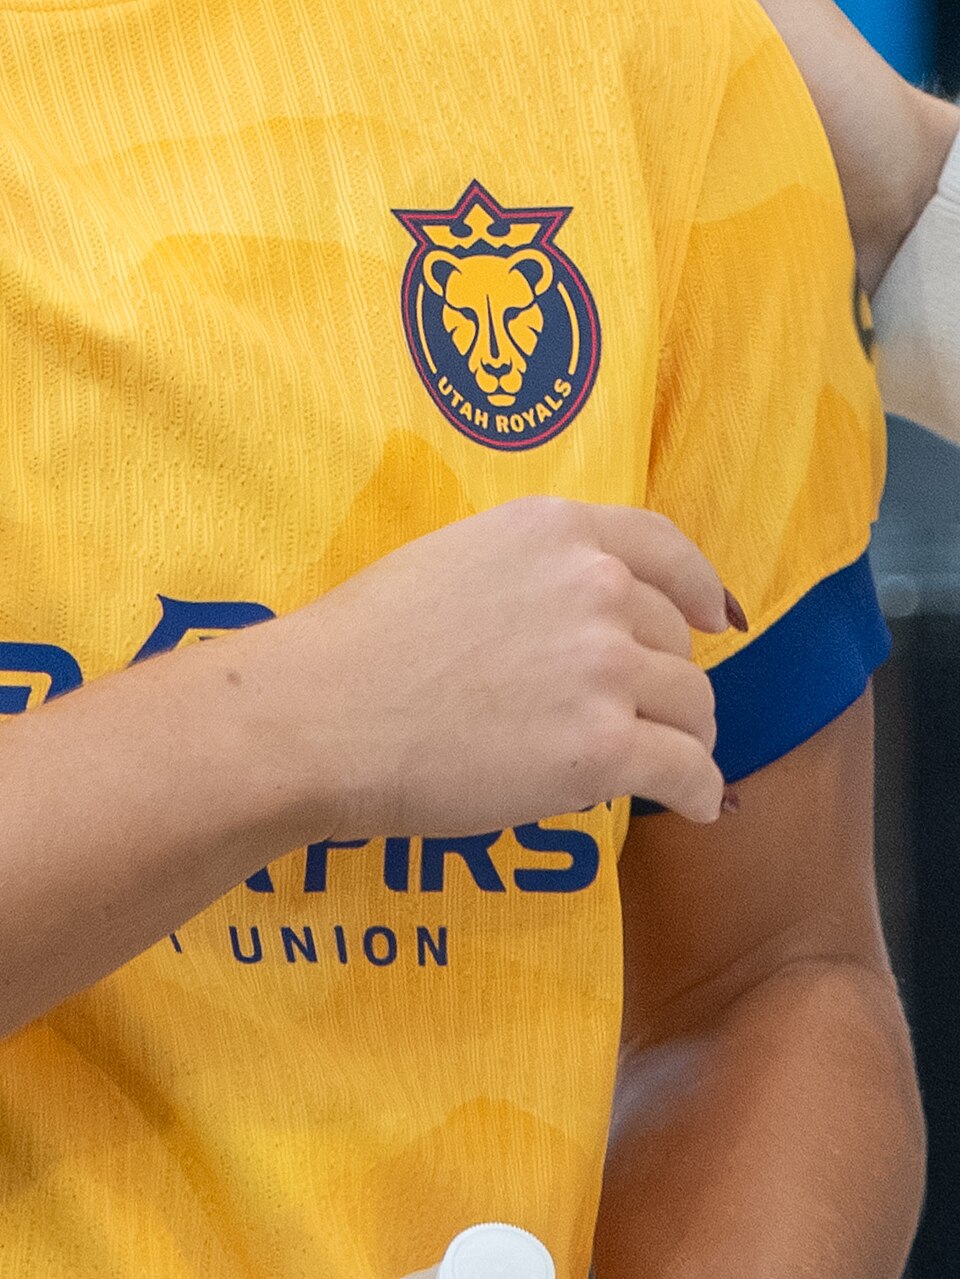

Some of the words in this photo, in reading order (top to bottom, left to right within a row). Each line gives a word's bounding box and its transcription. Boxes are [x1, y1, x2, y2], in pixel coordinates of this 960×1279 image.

[438, 376, 489, 429] UTAH
[495, 378, 572, 433] ROYALS
[229, 925, 448, 966] UNION
